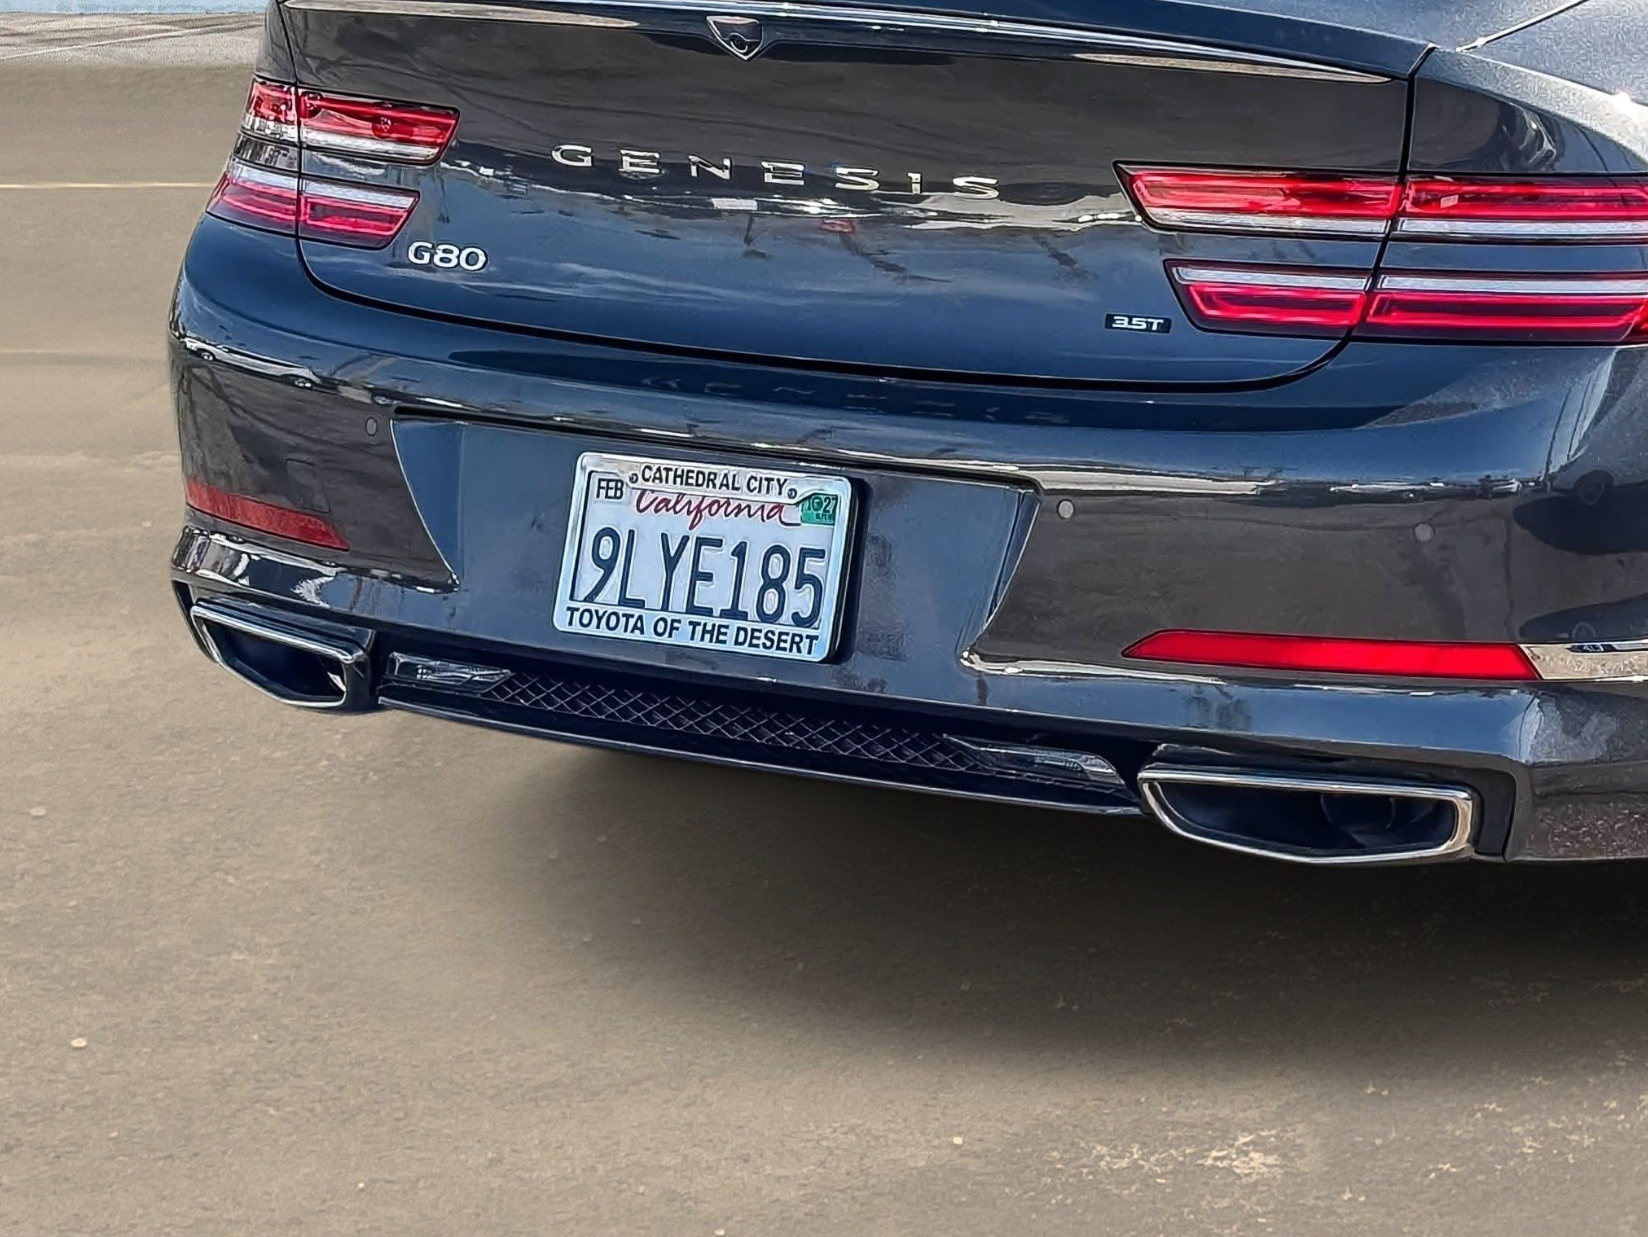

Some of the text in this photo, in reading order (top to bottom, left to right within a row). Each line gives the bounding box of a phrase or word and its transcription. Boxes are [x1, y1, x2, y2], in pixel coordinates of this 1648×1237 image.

[550, 144, 1000, 200] GENESIS
[407, 241, 489, 272] G80
[596, 478, 625, 500] FEB
[641, 464, 788, 497] CATHEDRAL CITY
[635, 489, 801, 531] California
[582, 526, 826, 628] 9LYE185
[566, 606, 820, 656] TOYOTA OF THE DESERT
